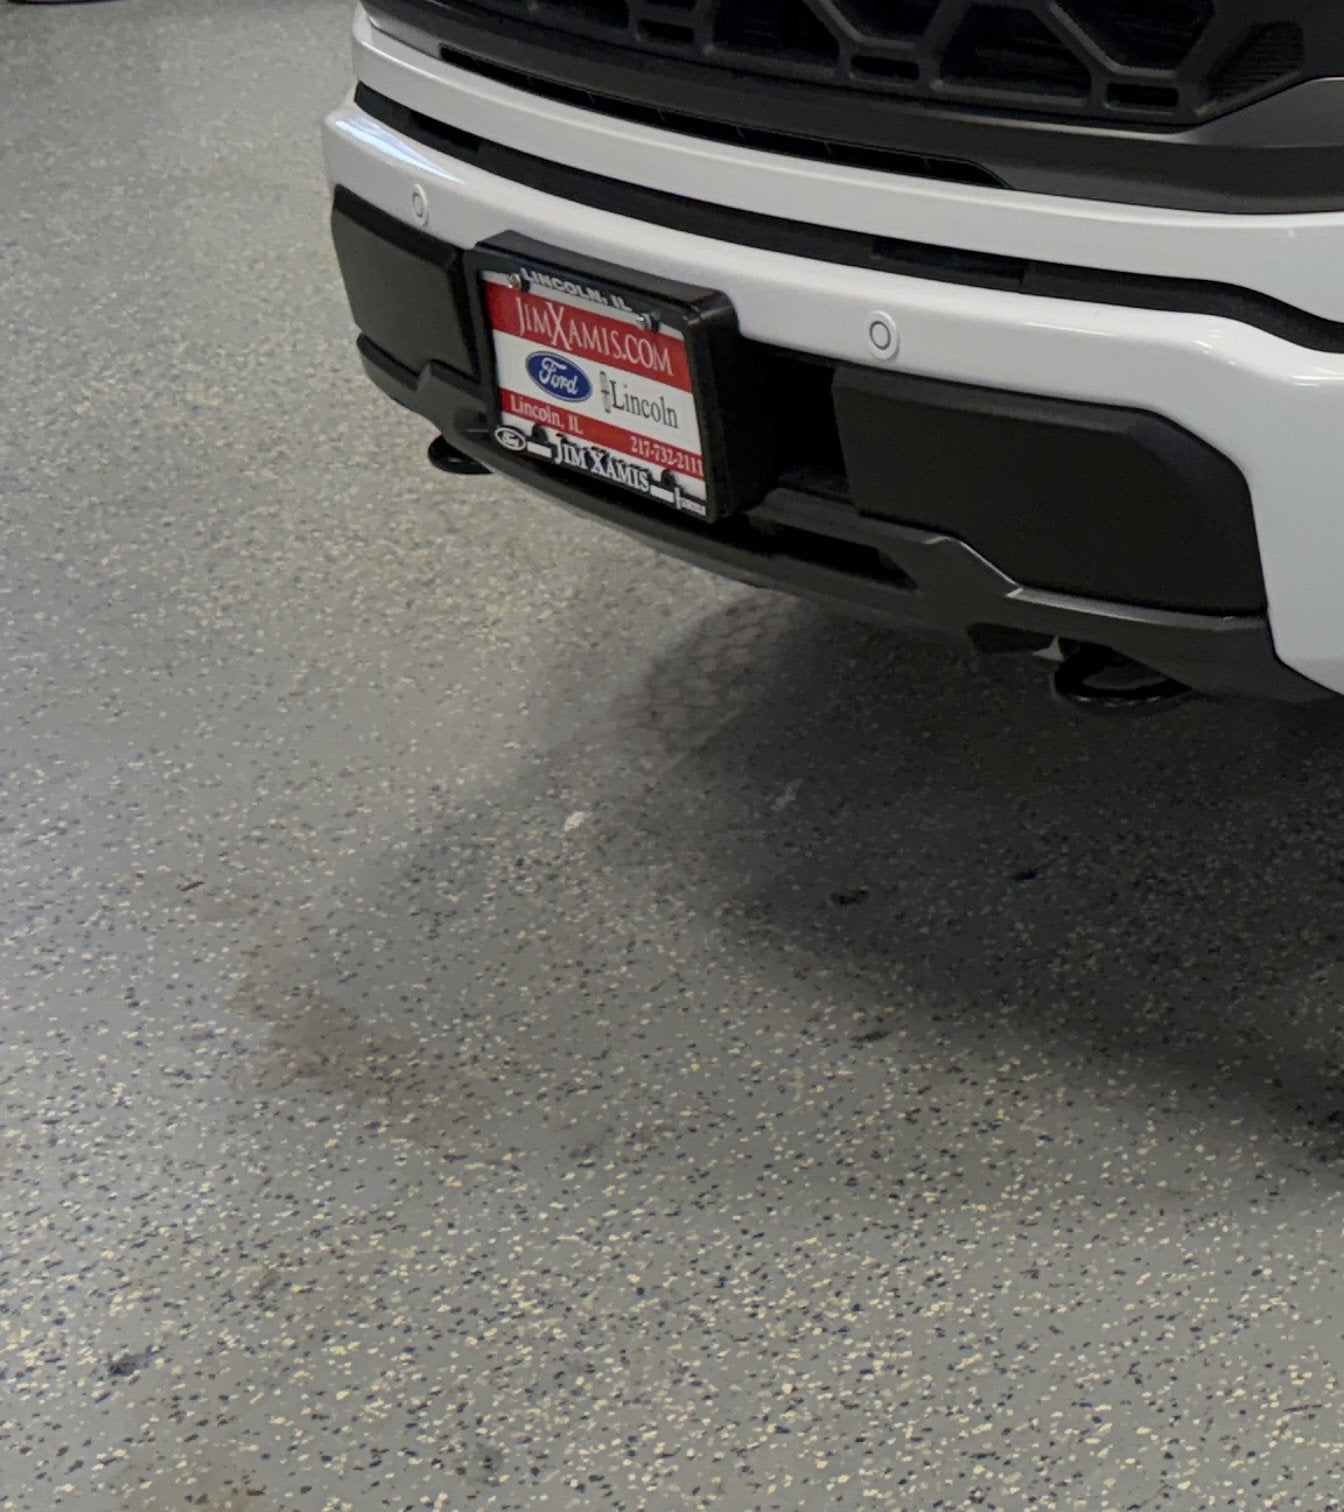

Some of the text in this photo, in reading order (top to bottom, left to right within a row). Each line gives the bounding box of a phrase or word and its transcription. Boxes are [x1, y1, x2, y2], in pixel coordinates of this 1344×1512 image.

[520, 267, 632, 313] LINCOLN, IL
[515, 296, 674, 377] JIMXAMIS.COM
[538, 356, 579, 396] Ford
[510, 394, 583, 436] Lincoln, IL
[609, 379, 680, 430] Lincoln
[554, 437, 588, 470] JIM
[591, 450, 650, 493] XAMIS
[630, 435, 704, 477] 217-732-2111
